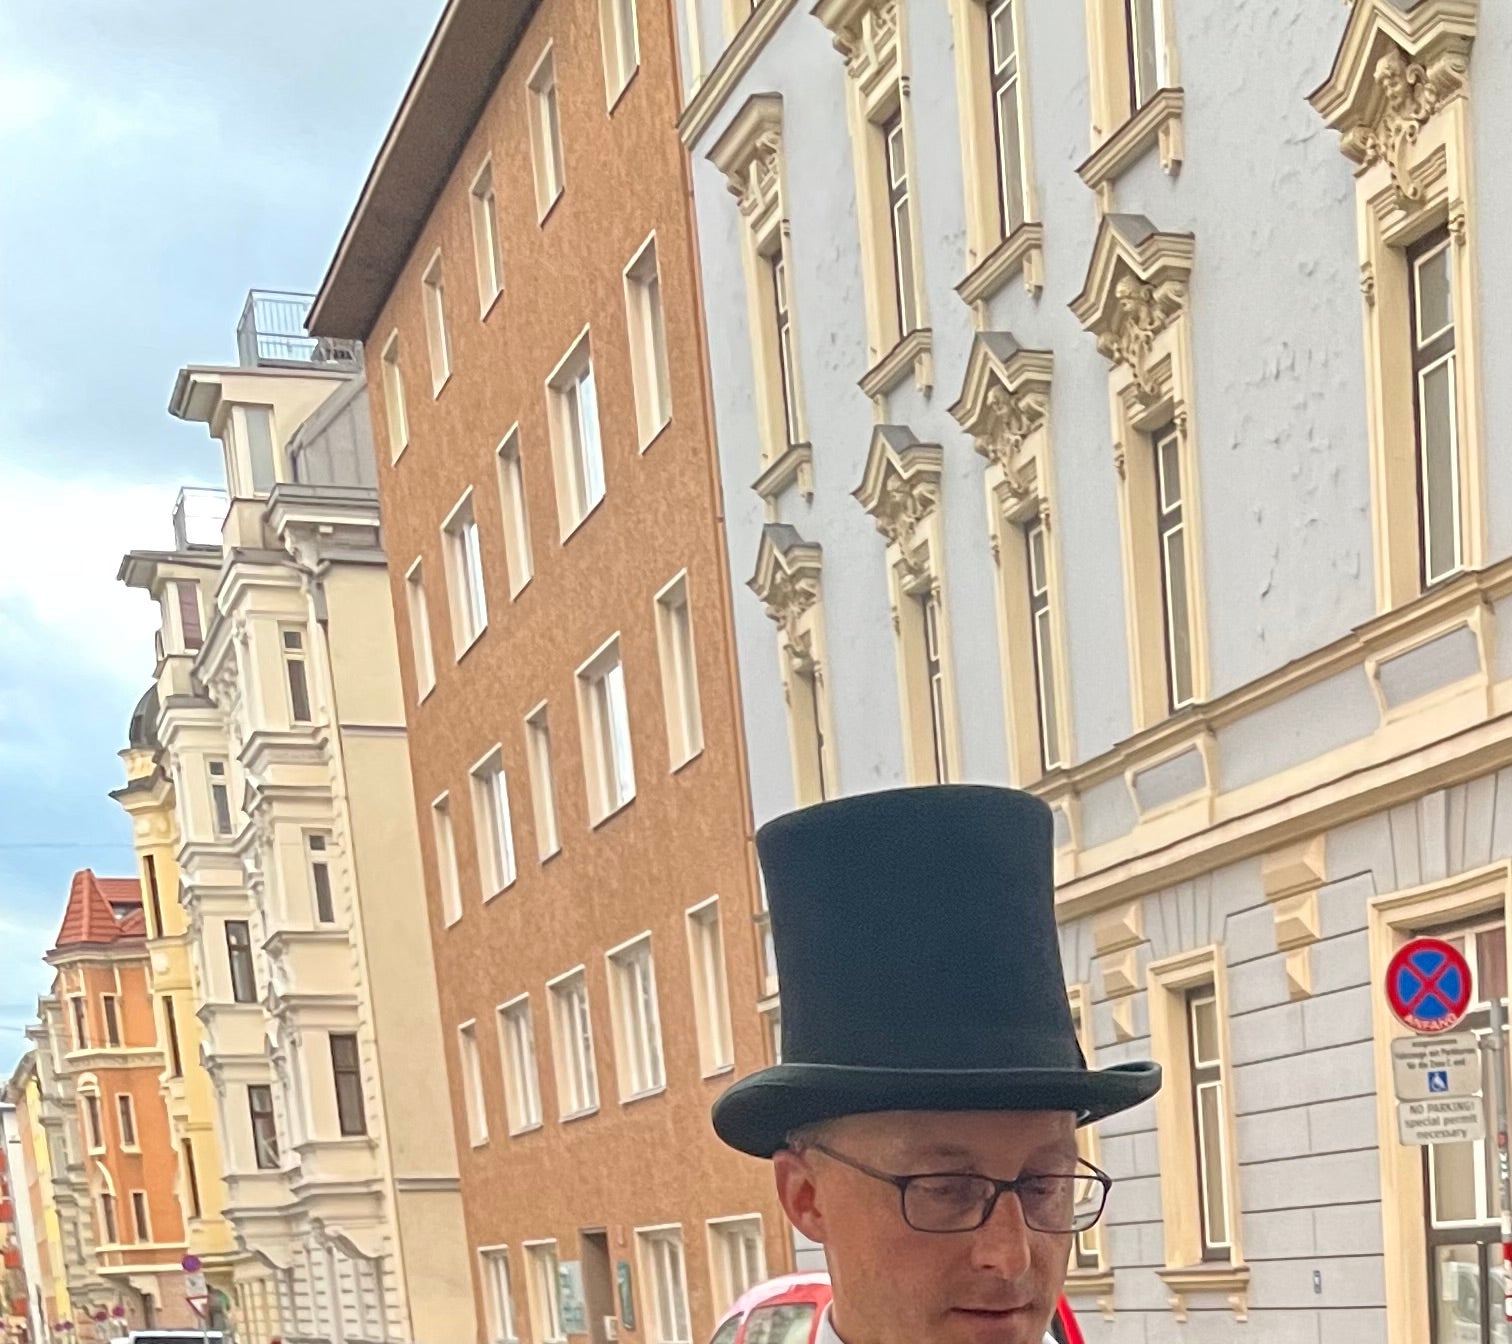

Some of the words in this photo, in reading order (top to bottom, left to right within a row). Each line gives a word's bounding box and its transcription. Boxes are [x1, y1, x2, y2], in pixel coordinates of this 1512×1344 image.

[1404, 1013, 1458, 1030] ANFANG
[1409, 1104, 1425, 1115] NO
[1405, 1116, 1441, 1128] special
[1443, 1114, 1478, 1127] permit
[1416, 1129, 1467, 1139] necessary
